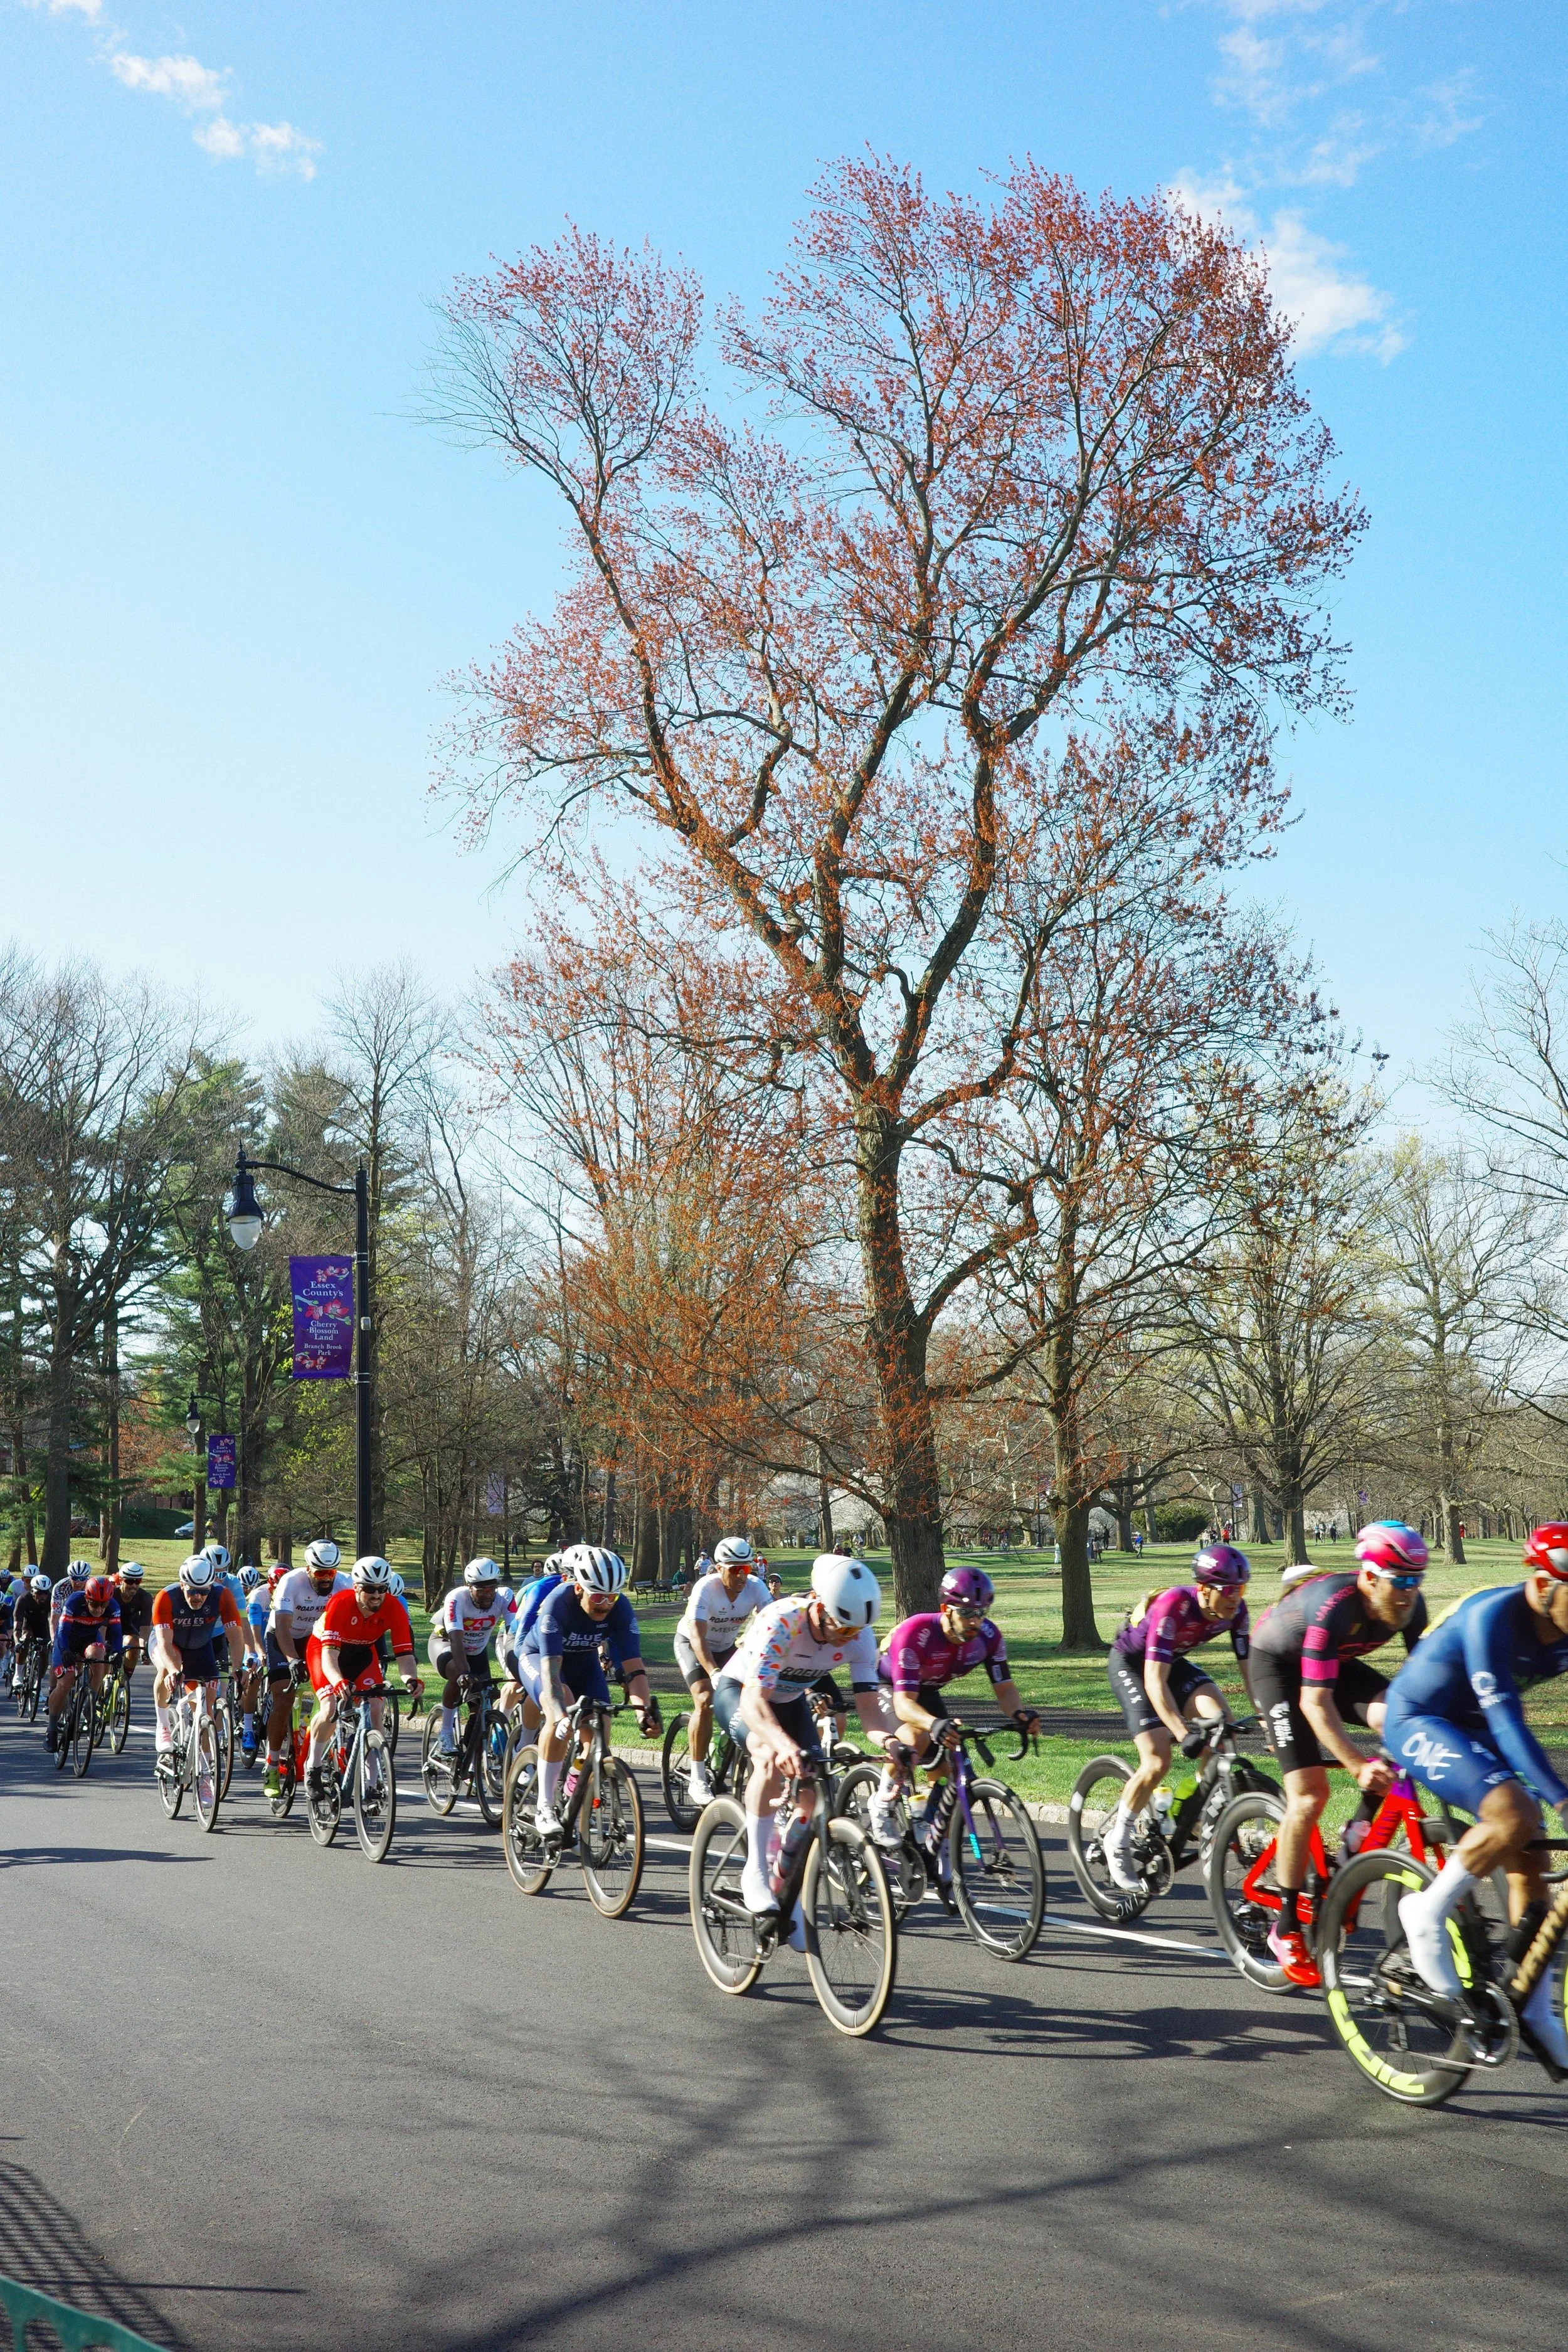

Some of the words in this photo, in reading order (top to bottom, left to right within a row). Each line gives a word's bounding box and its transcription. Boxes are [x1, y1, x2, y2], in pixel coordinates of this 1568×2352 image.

[302, 1289, 344, 1299] County's
[310, 1320, 337, 1329] Cherry
[568, 1631, 602, 1642] BLUE
[562, 1637, 600, 1647] IBBO
[1118, 1670, 1143, 1704] ONYX
